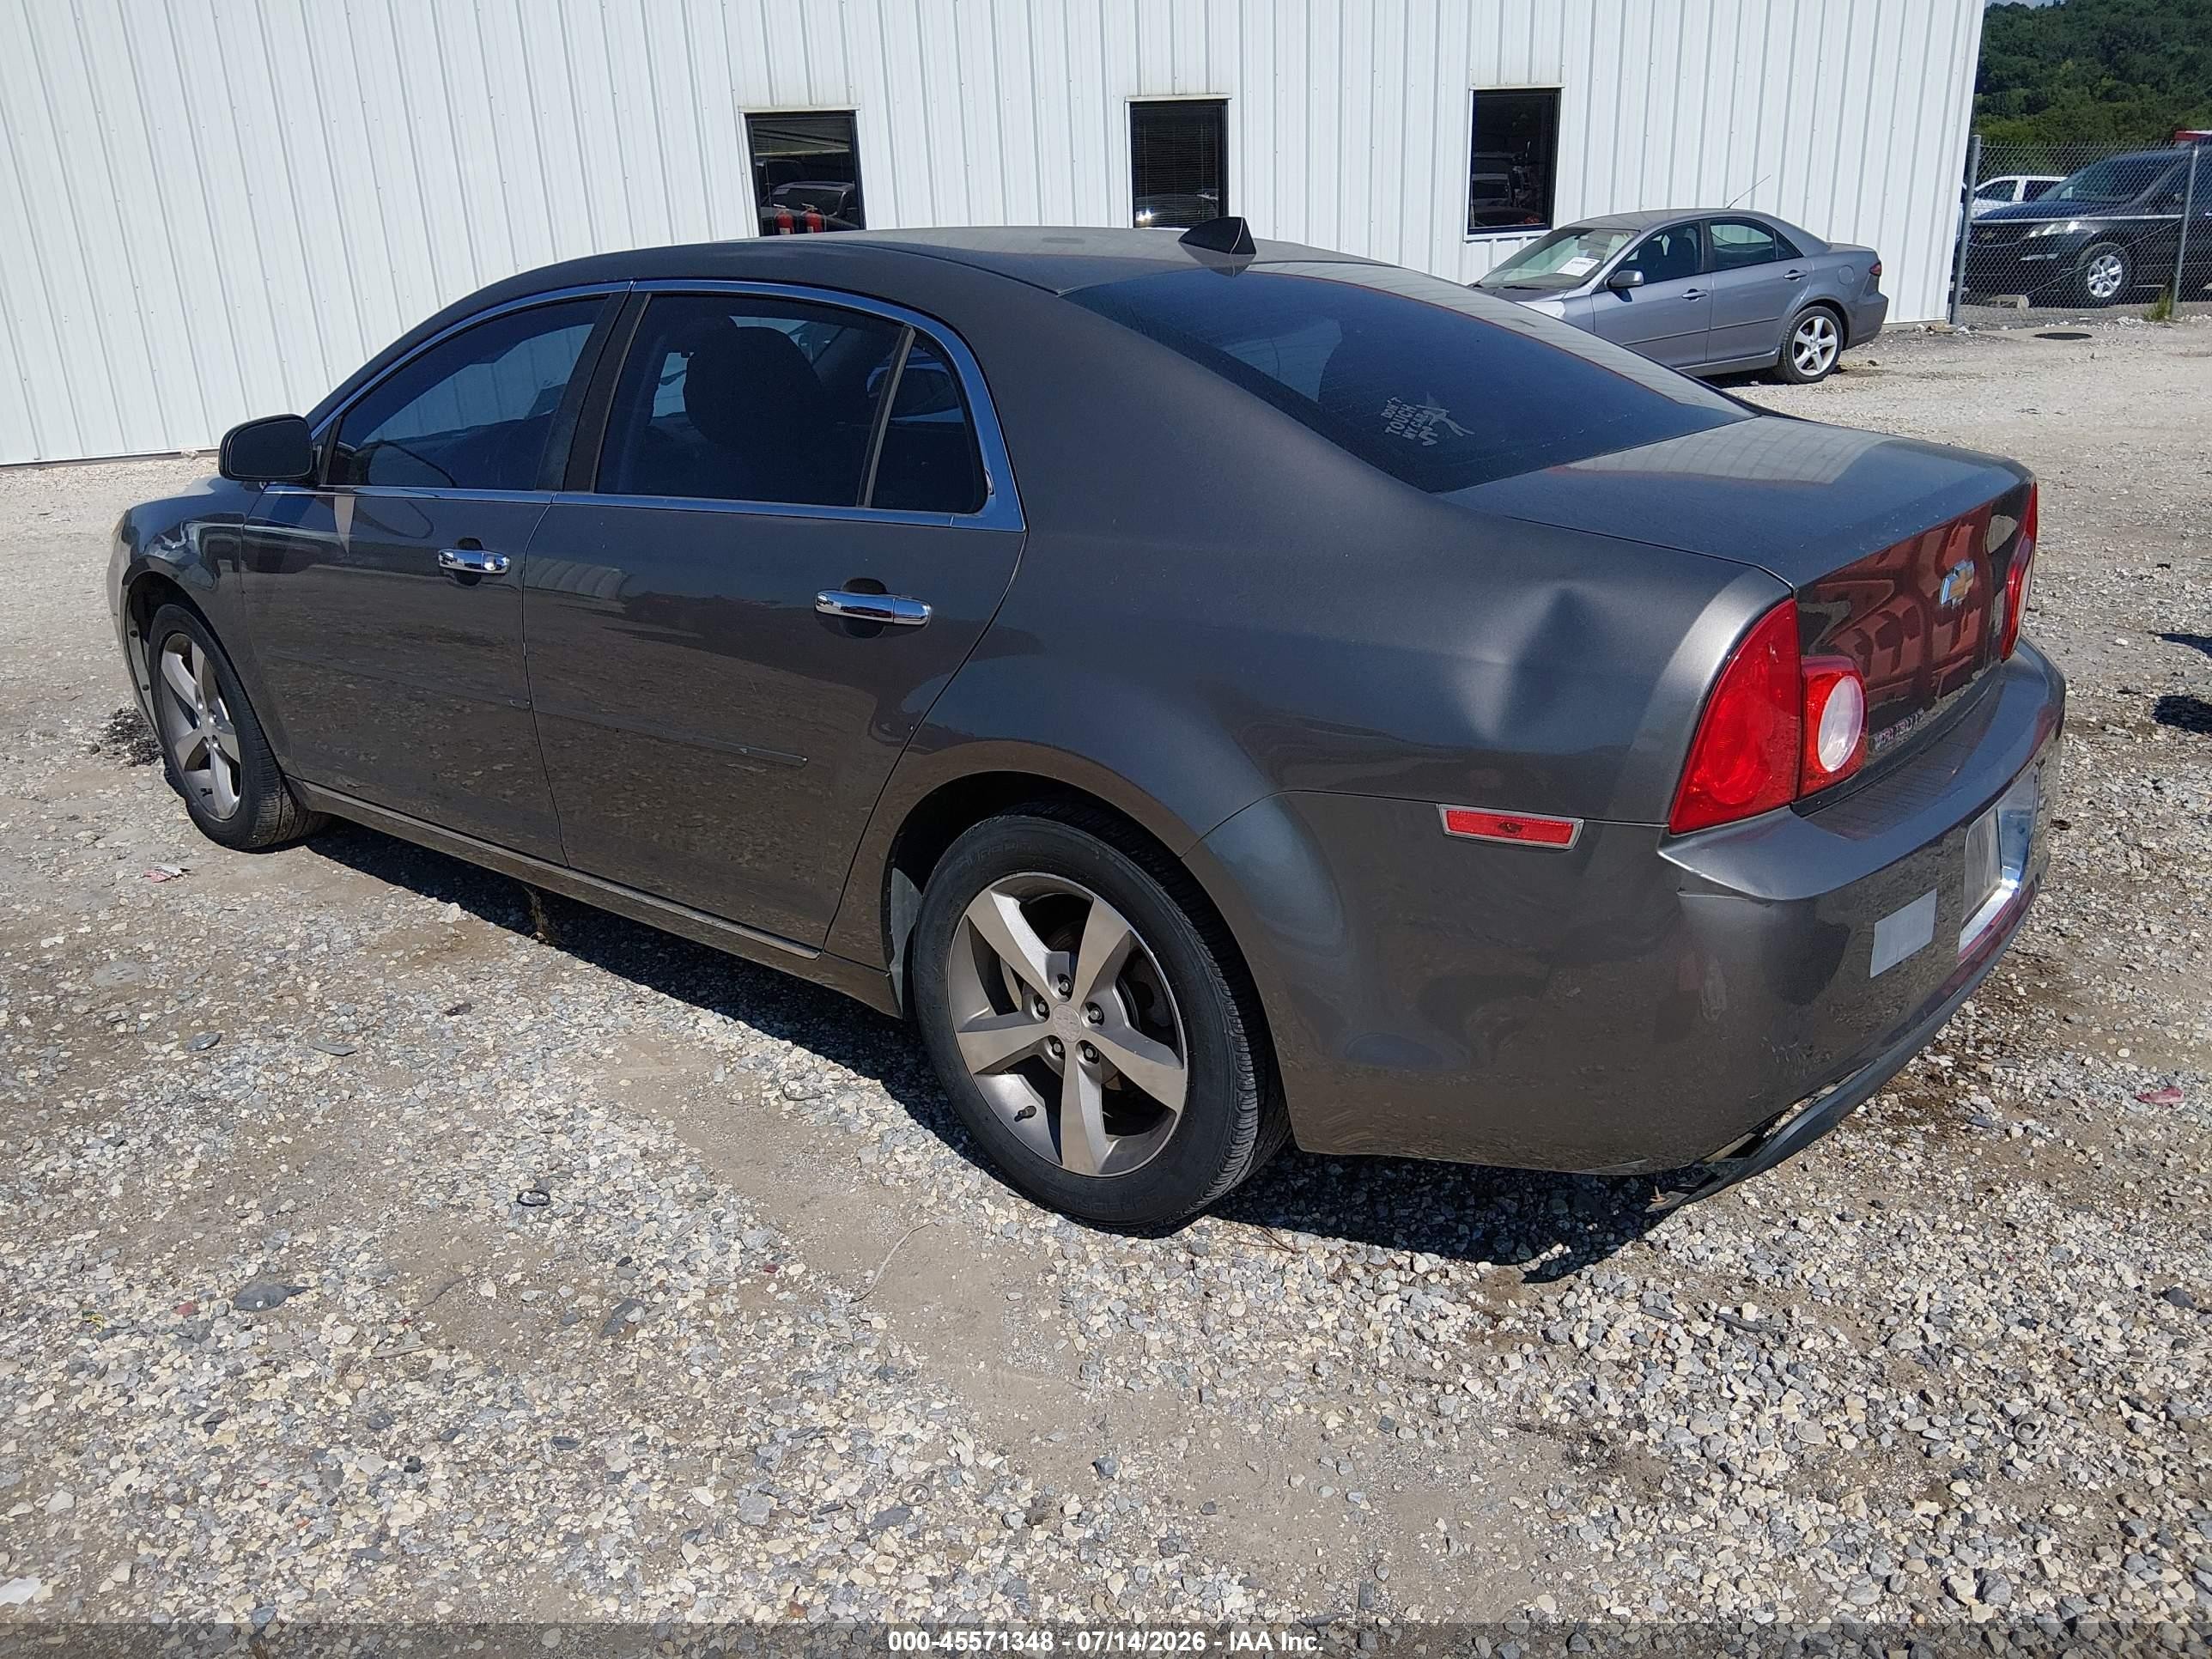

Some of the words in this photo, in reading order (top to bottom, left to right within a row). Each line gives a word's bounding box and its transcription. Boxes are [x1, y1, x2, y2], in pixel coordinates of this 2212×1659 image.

[1381, 397, 1402, 419] DON'T
[1384, 404, 1418, 436] TOUCH
[1401, 425, 1419, 441] MY
